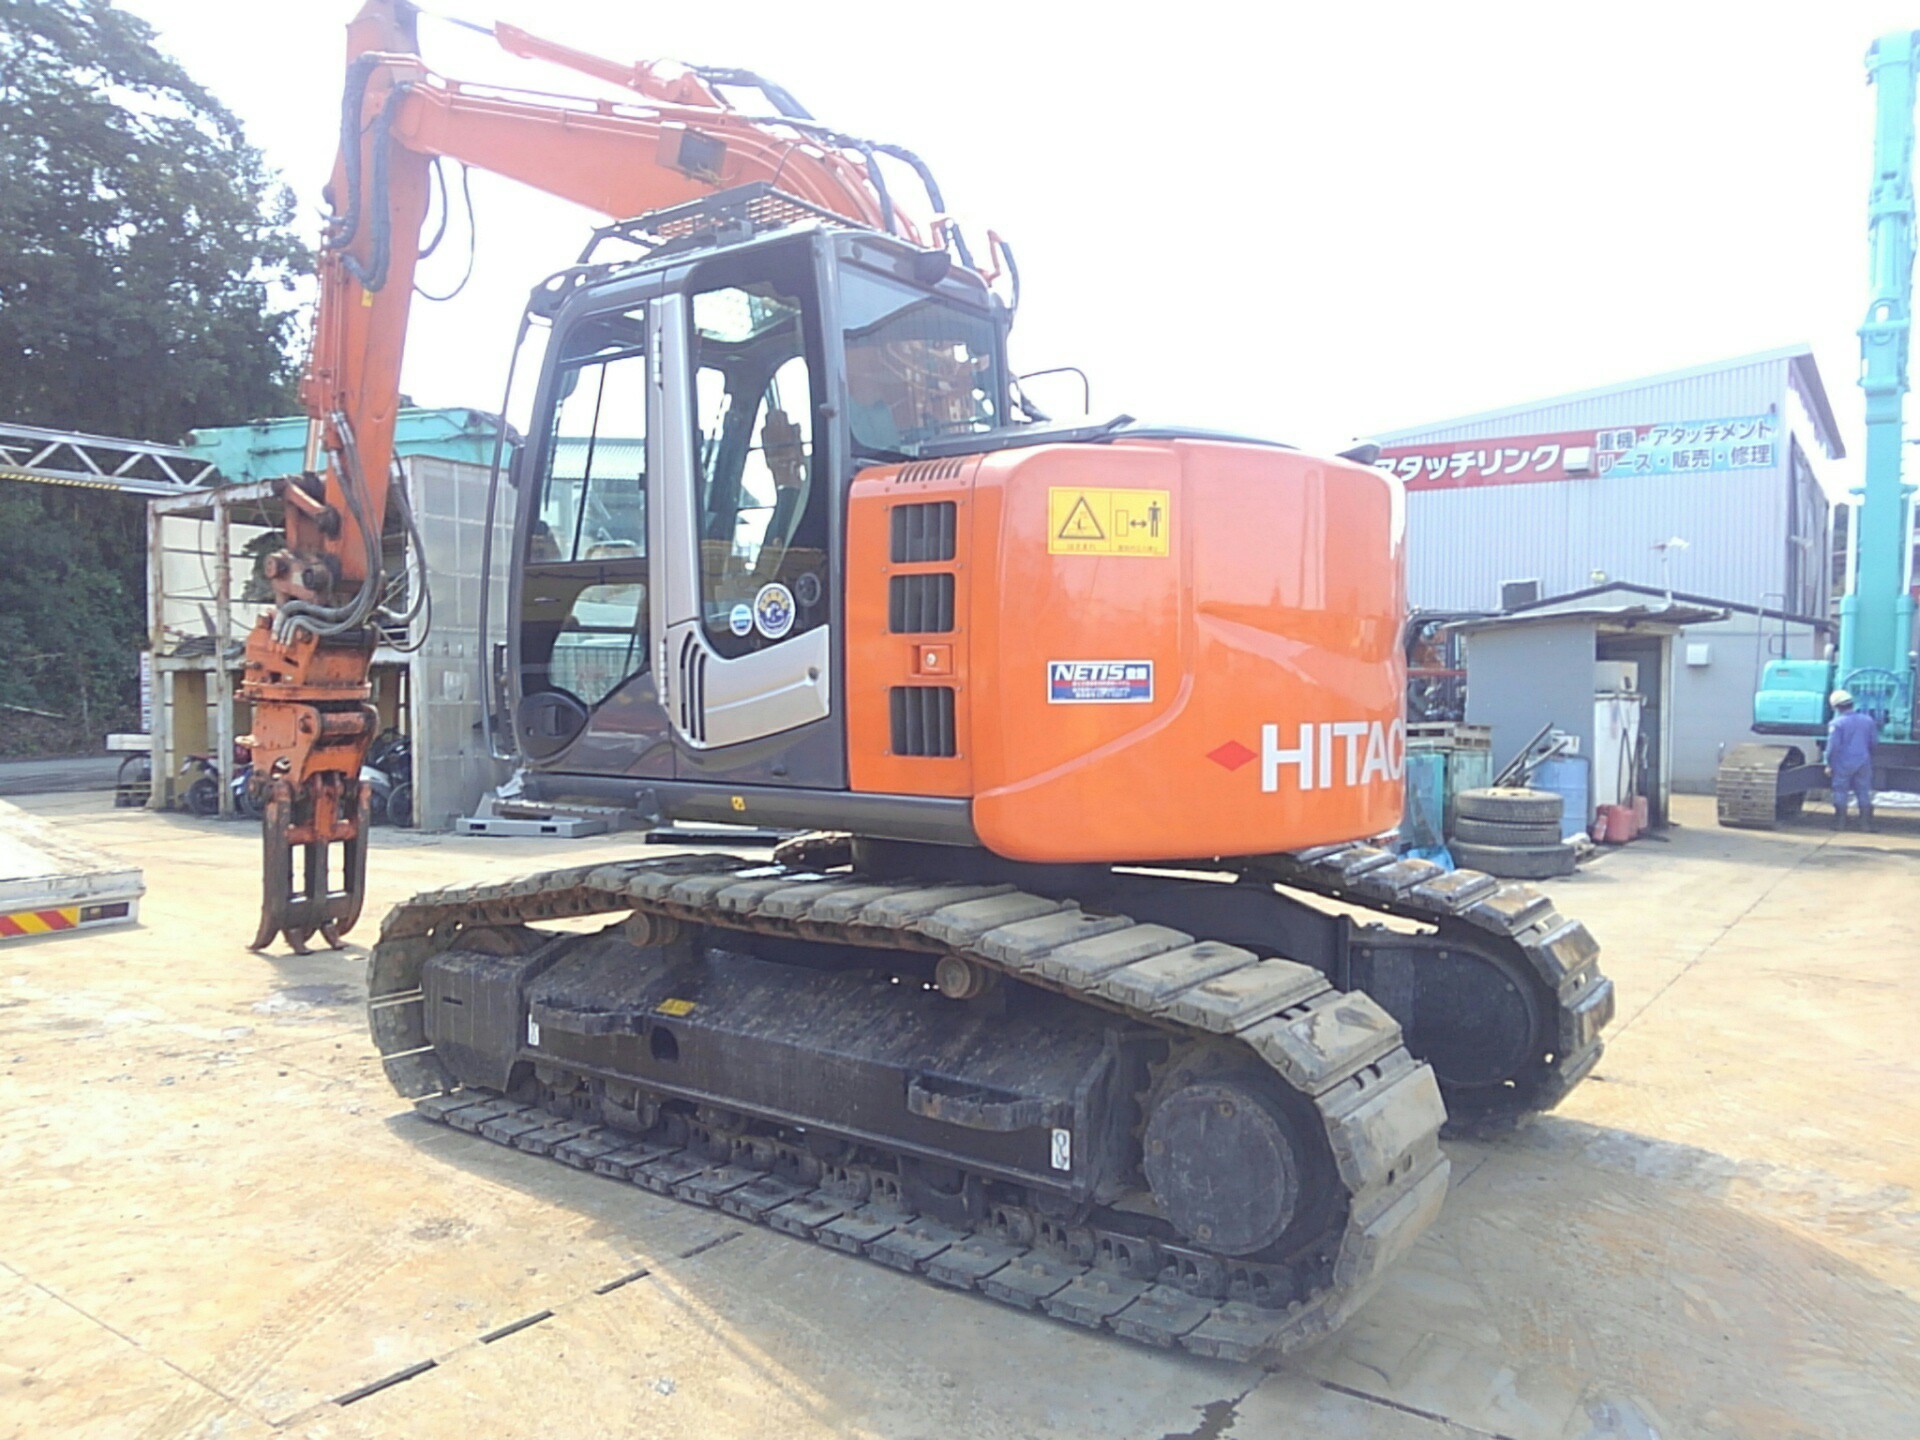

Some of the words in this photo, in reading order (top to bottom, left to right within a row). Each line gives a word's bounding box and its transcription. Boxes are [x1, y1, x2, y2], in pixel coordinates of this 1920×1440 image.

[1598, 419, 1772, 451] 重機・アタッチメント
[1599, 443, 1771, 473] リース・販売・修理
[1054, 664, 1125, 681] NETIS
[1261, 717, 1405, 792] HITAC
